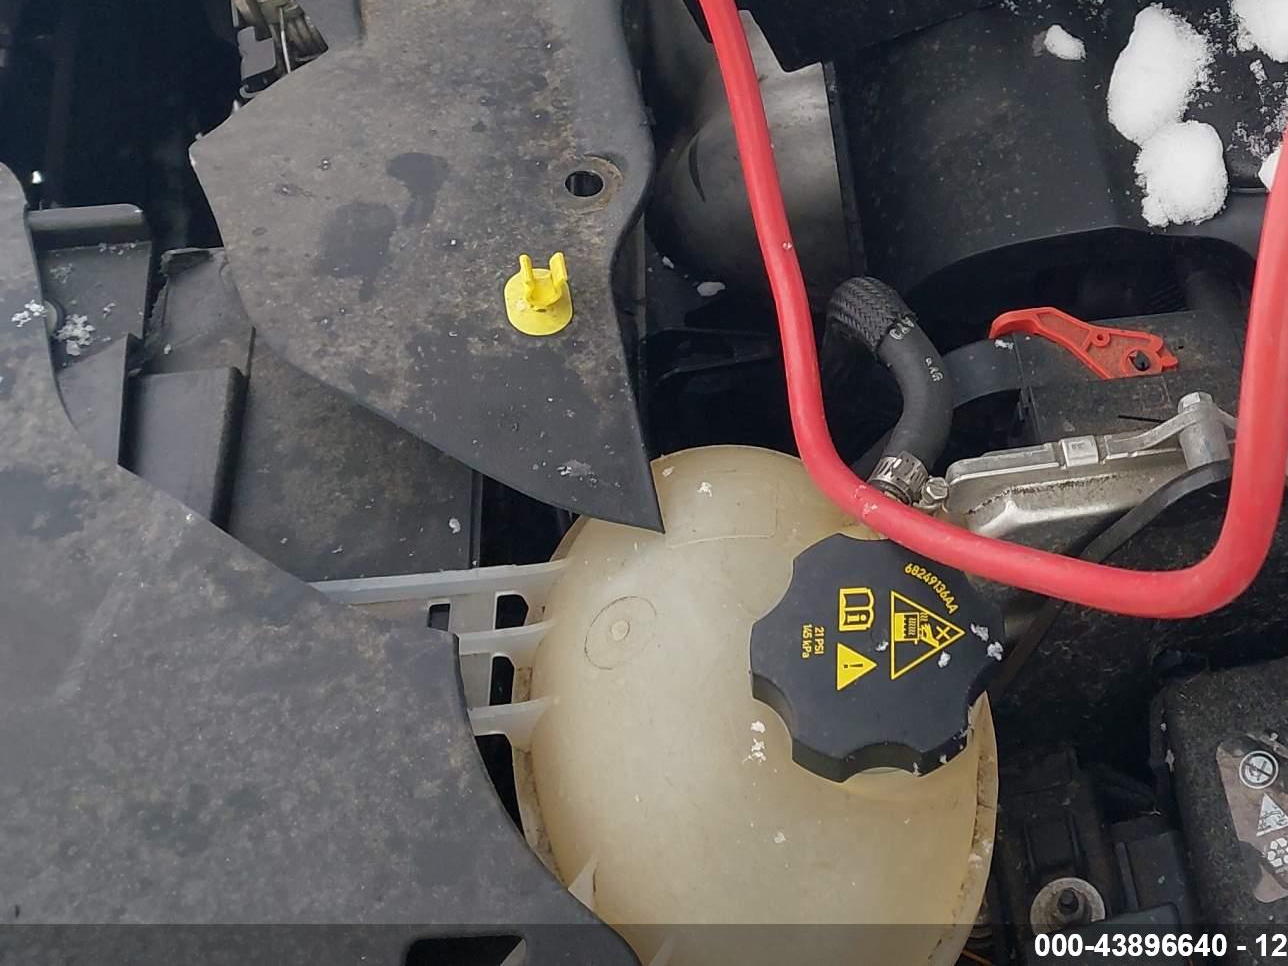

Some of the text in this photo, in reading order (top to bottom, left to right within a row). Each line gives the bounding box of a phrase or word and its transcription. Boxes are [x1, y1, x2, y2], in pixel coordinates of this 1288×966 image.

[904, 562, 960, 614] 68249136AA
[801, 624, 813, 658] 145 kPa
[813, 626, 825, 654] 21 PSI
